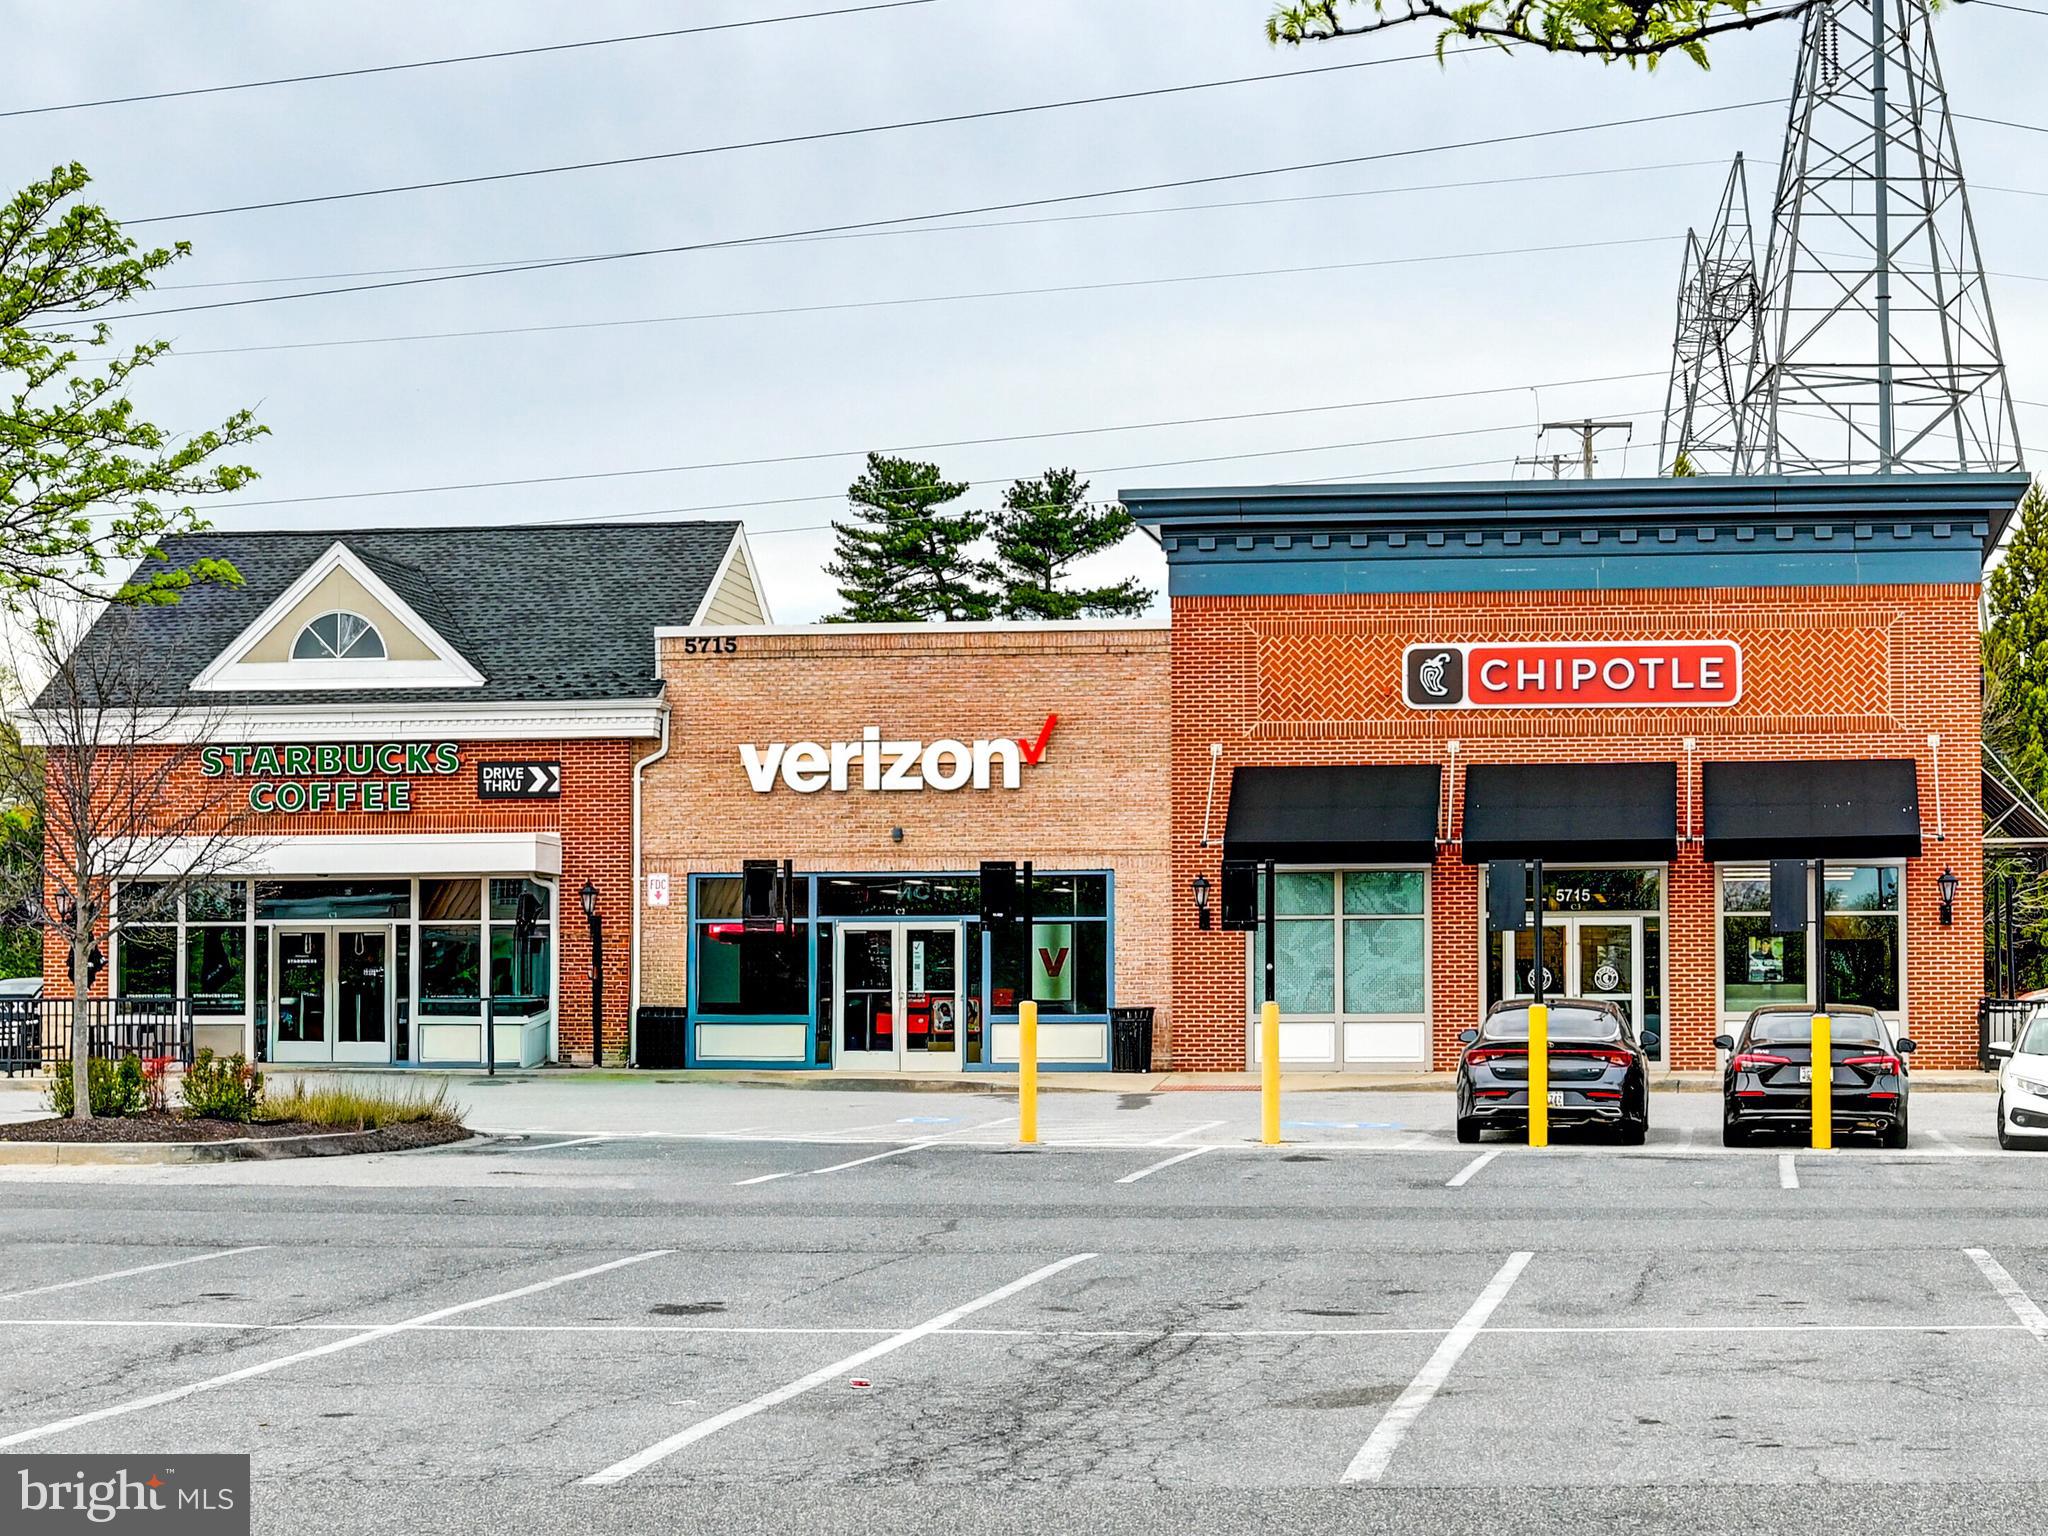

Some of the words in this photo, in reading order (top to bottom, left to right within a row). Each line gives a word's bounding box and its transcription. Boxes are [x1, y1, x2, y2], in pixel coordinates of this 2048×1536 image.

[685, 637, 737, 654] 5715
[1480, 656, 1725, 692] CHIPOTLE
[200, 742, 460, 777] STARBUCKS
[738, 726, 1021, 793] verizon
[483, 767, 525, 779] DRIVE
[483, 780, 521, 792] THRU
[249, 780, 412, 814] COFFEE
[650, 879, 667, 890] FDC
[1555, 889, 1591, 902] 5715
